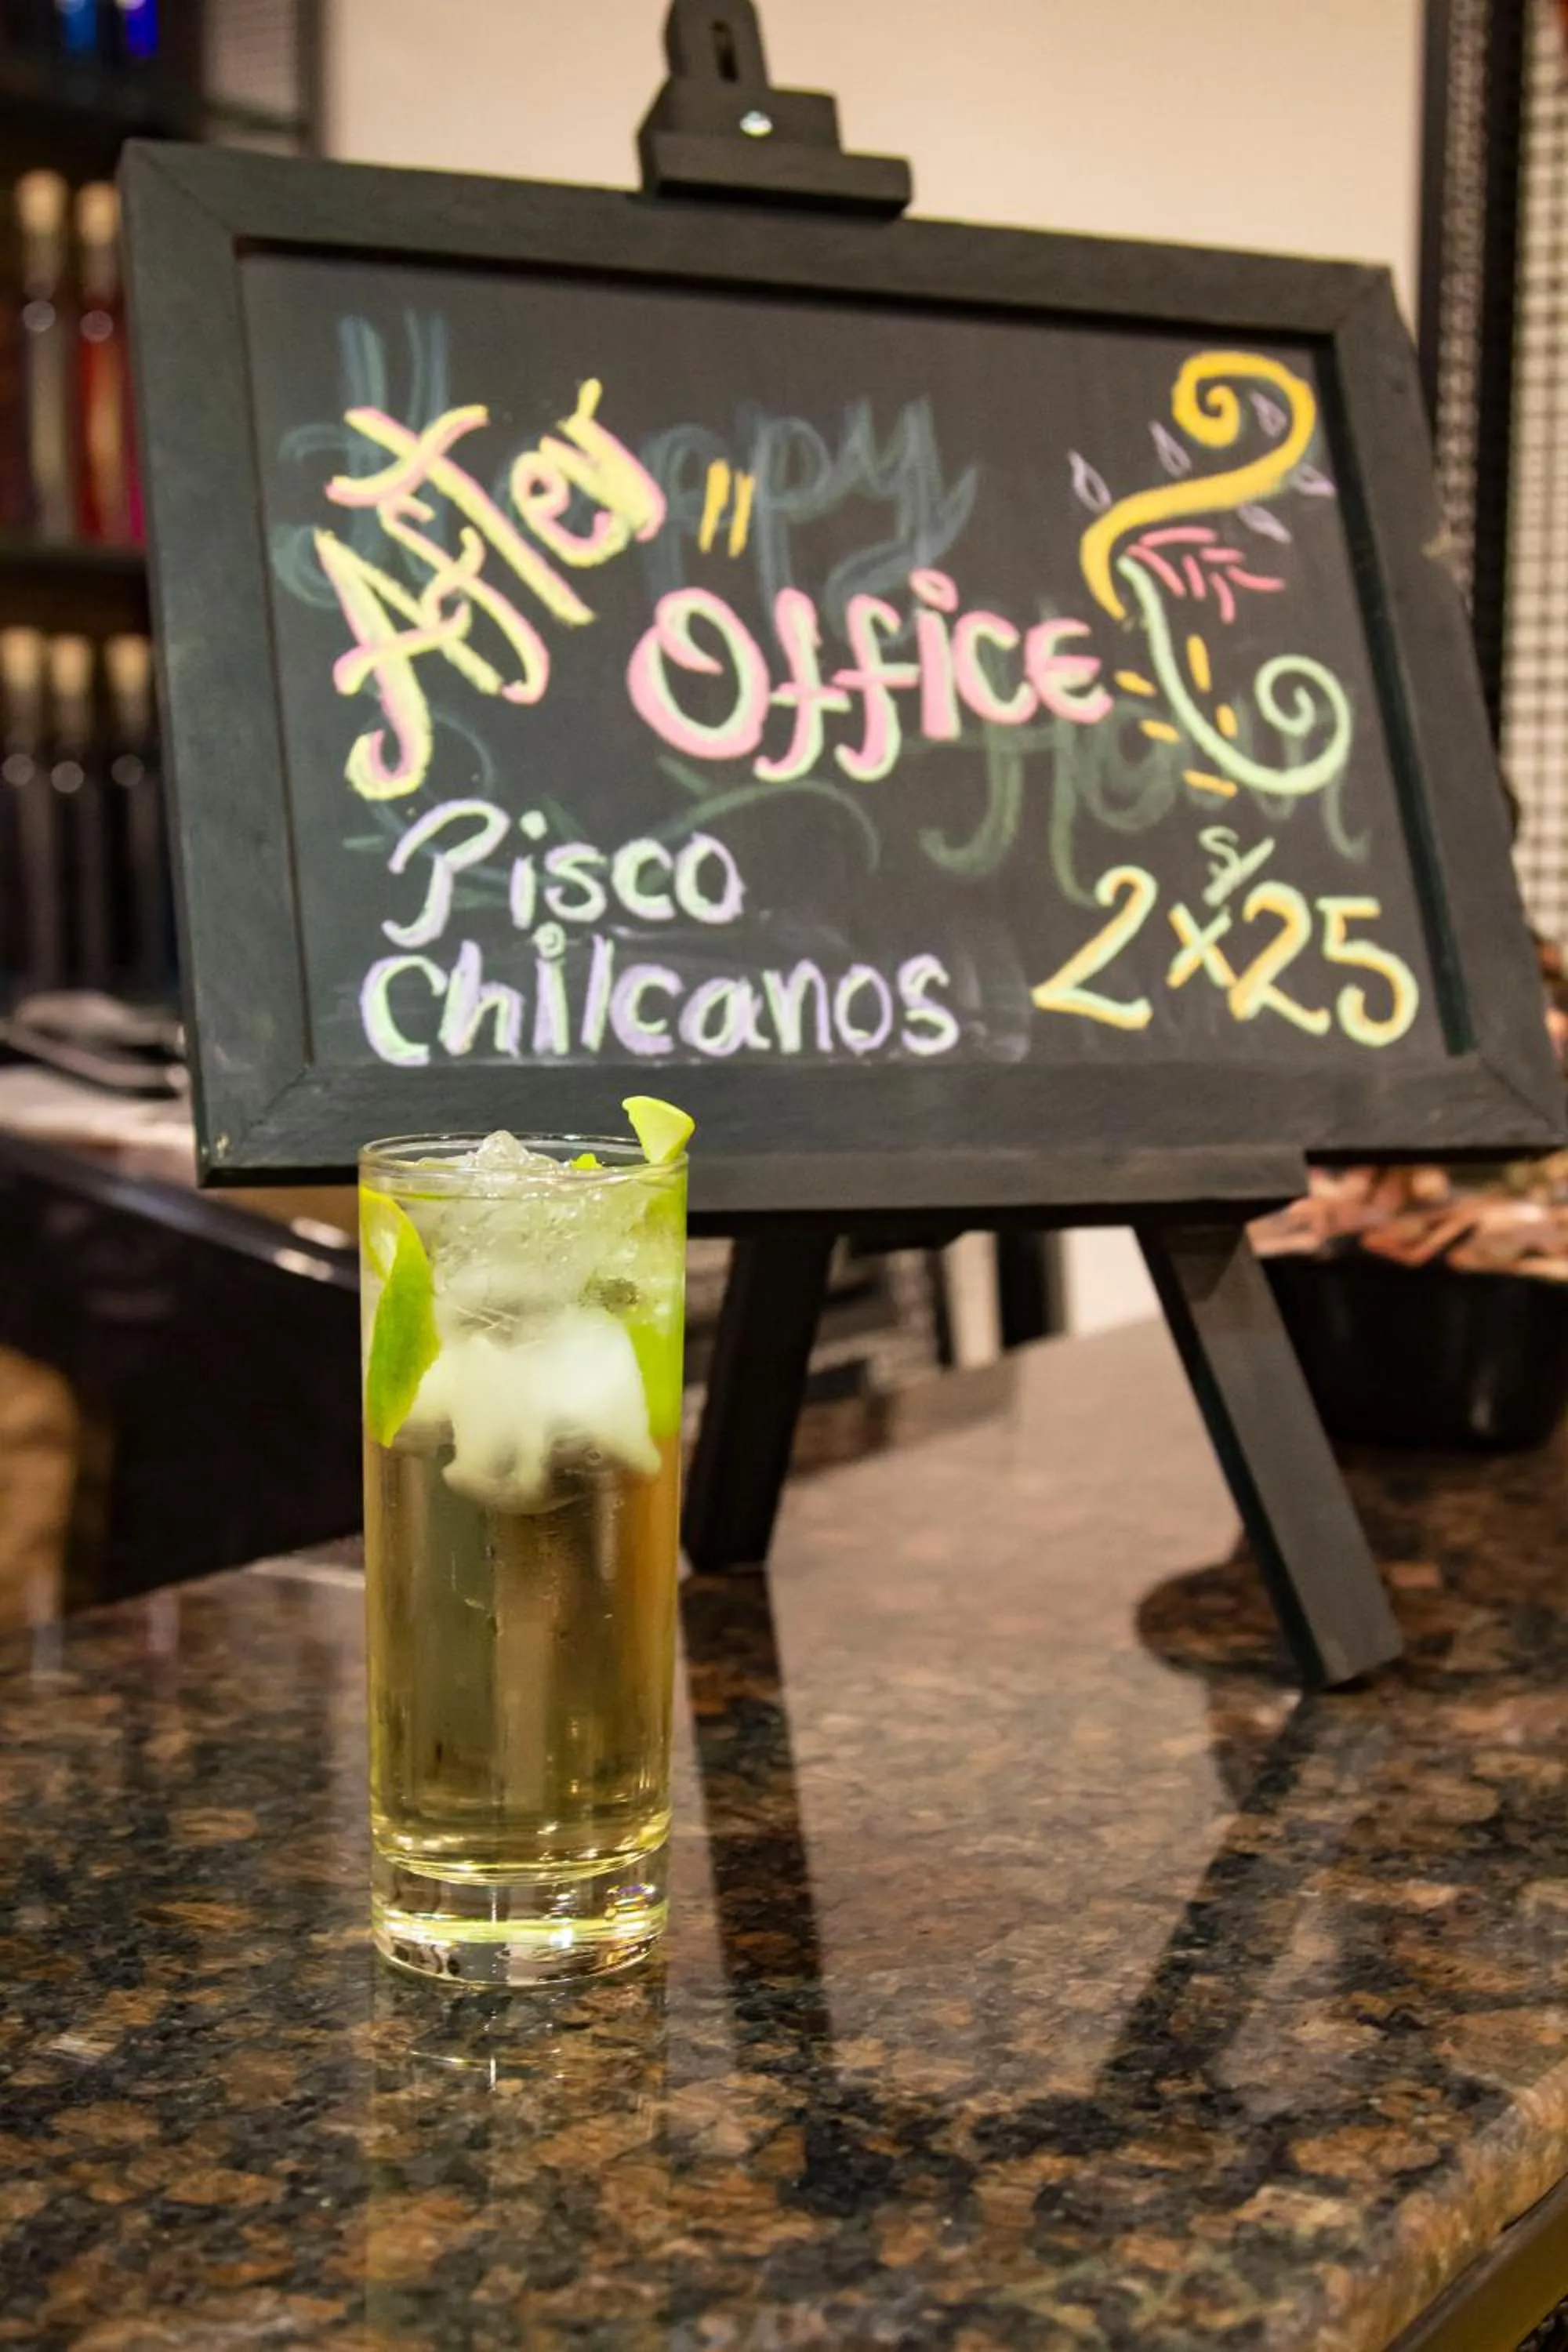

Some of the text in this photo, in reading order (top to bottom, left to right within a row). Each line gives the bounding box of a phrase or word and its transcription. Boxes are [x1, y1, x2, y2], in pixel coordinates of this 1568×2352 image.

[315, 378, 666, 800] After
[628, 567, 1113, 782] Office
[383, 799, 747, 947] Pisco
[360, 924, 960, 1067] Chilcanos
